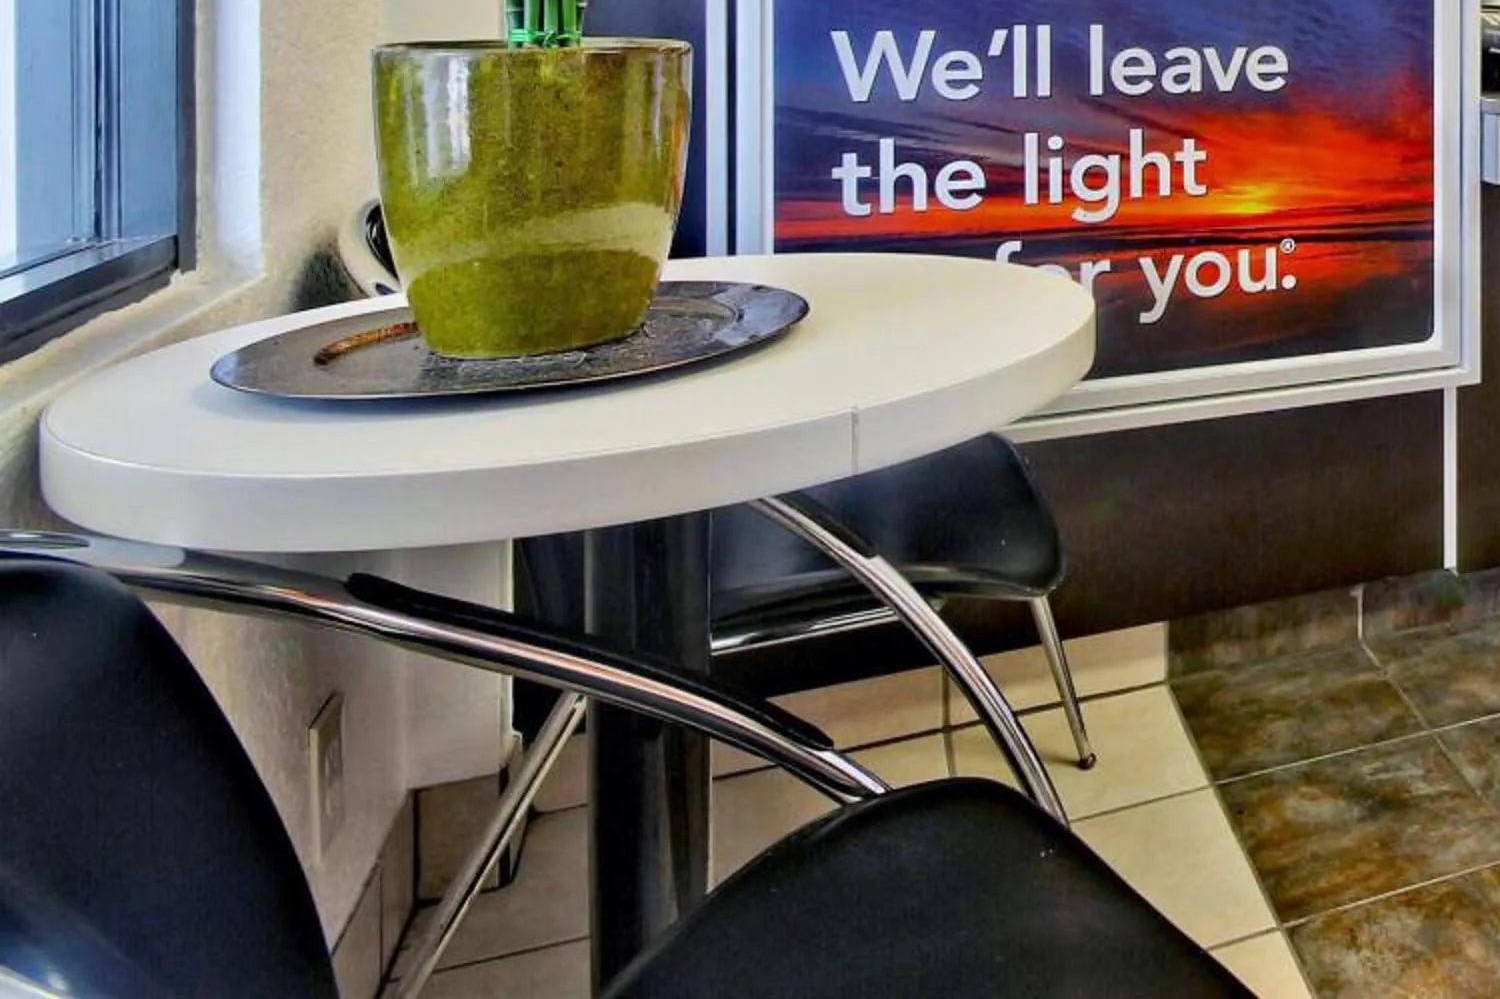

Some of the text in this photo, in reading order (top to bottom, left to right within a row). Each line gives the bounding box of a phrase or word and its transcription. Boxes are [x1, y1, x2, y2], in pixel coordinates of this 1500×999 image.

[831, 24, 1289, 102] We'll leave
[831, 128, 1207, 223] the light
